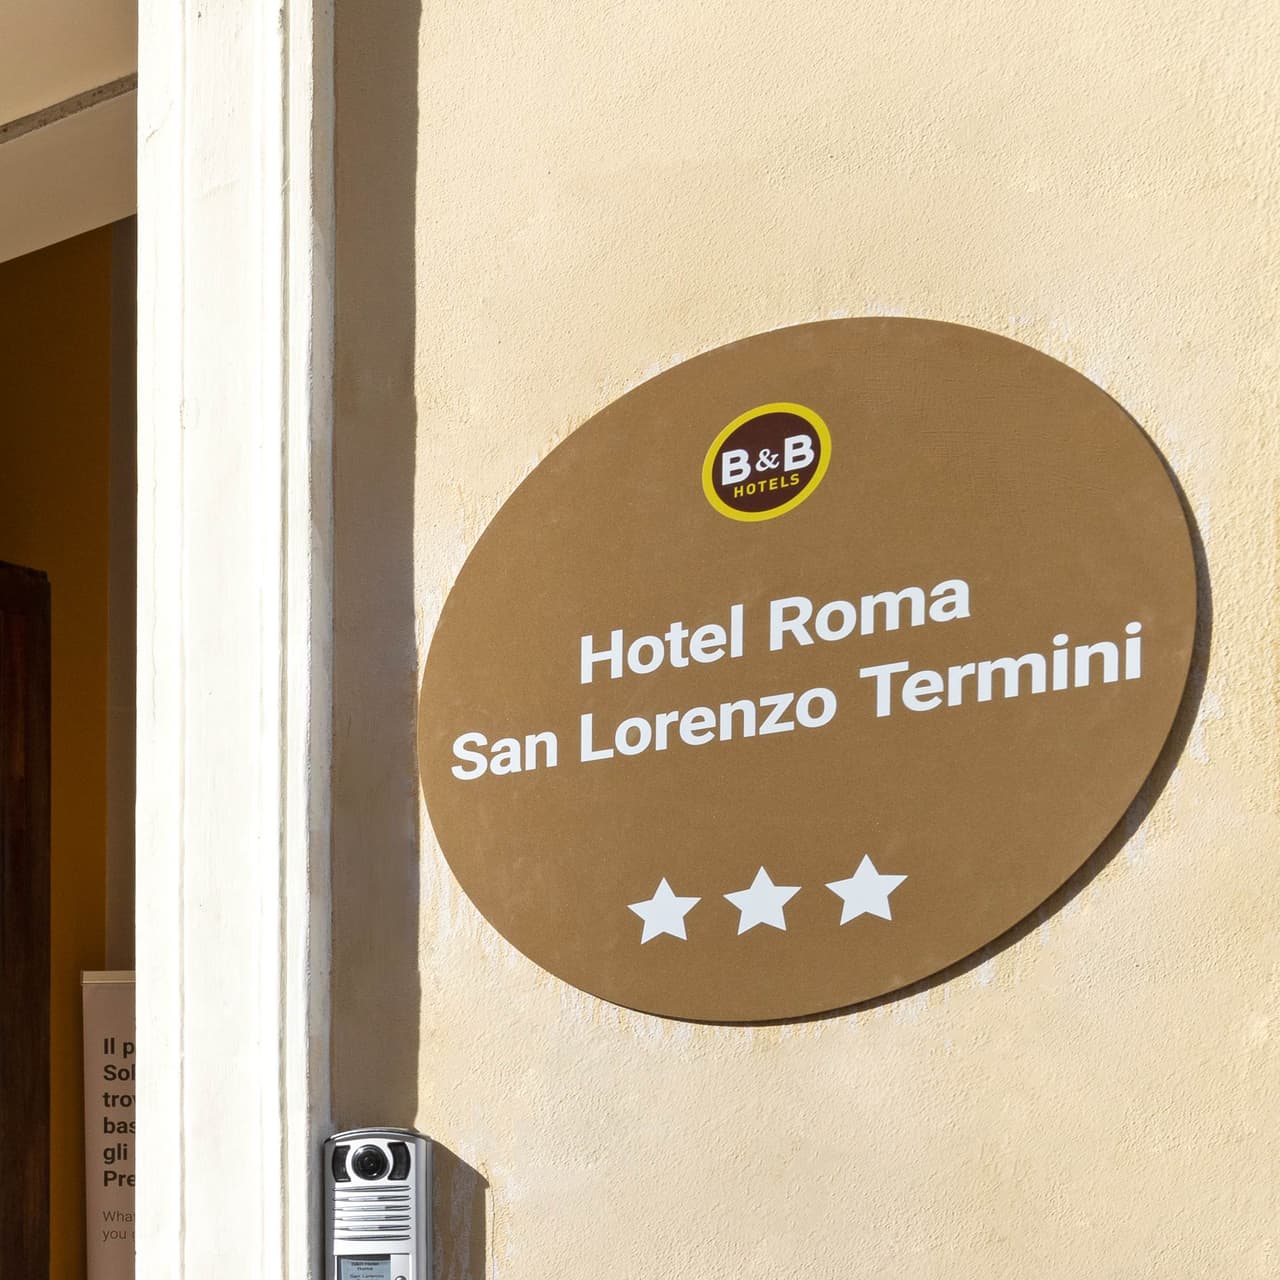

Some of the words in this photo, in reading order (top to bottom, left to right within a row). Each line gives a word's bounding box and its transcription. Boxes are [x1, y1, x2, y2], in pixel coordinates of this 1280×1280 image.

[722, 434, 815, 486] B&B
[734, 473, 800, 498] HOTELS
[580, 604, 744, 685] Hotel
[769, 579, 971, 652] Roma
[450, 731, 558, 781] San
[580, 687, 837, 763] Lorenzo
[859, 621, 1143, 718] Termini
[103, 1037, 115, 1055] Il
[103, 1143, 128, 1165] gli
[102, 1230, 127, 1242] you
